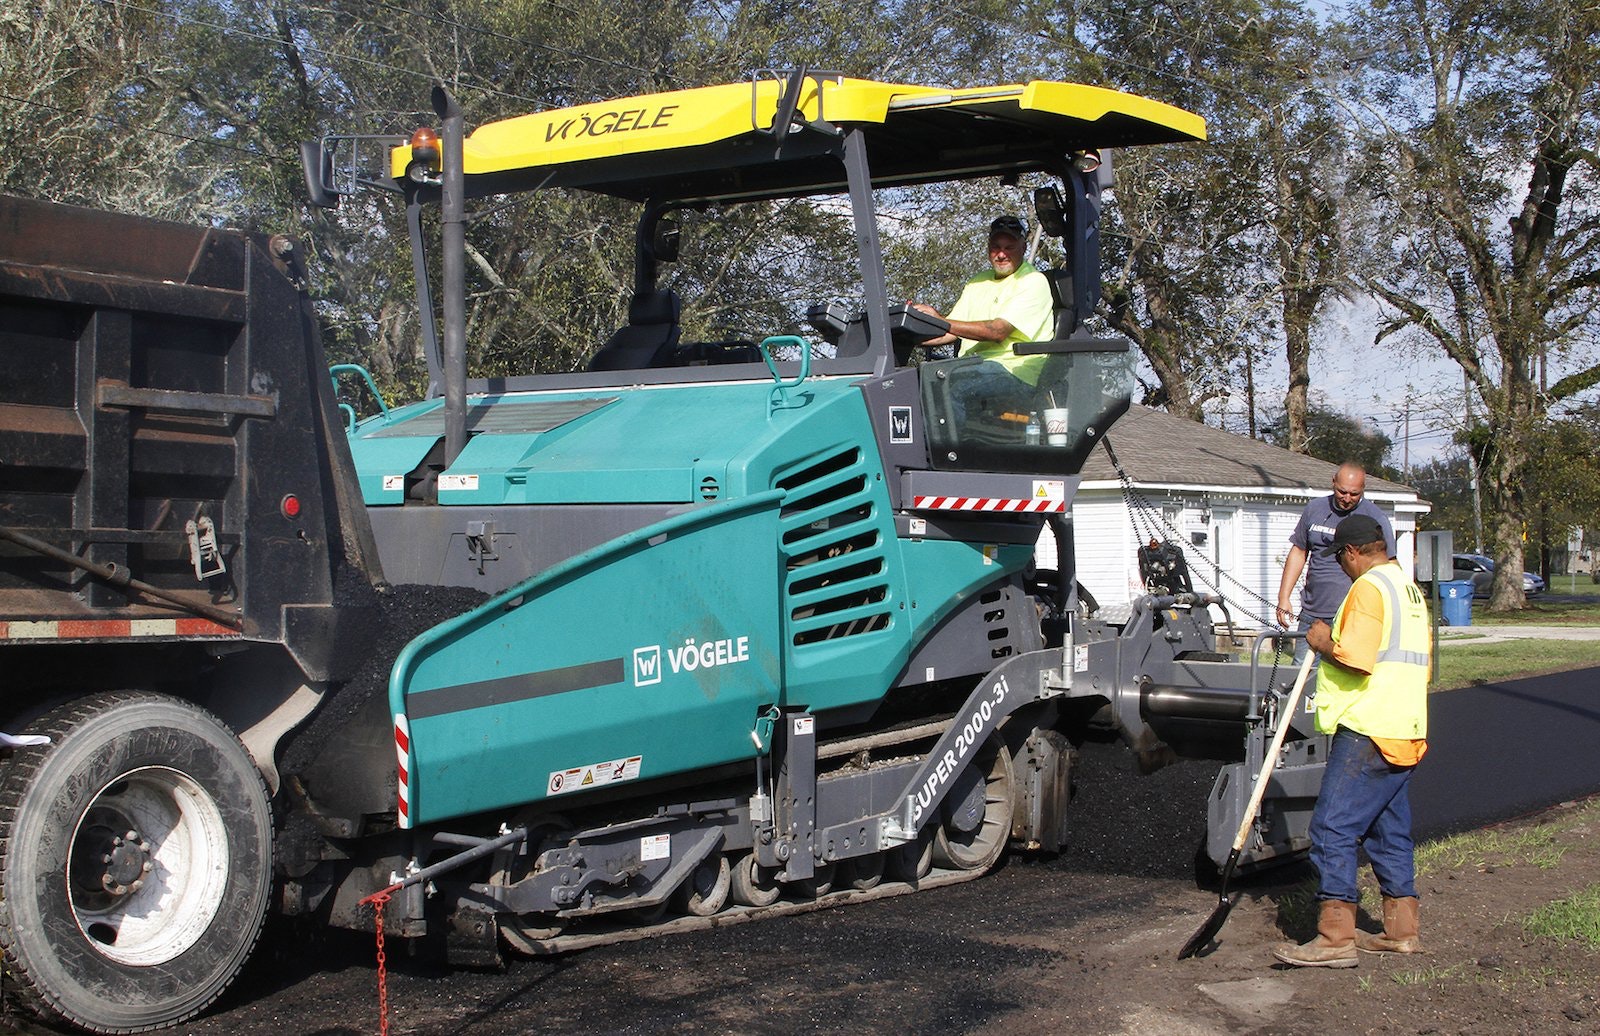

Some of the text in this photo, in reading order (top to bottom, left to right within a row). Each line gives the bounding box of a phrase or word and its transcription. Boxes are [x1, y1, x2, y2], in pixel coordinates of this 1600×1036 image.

[545, 105, 680, 143] VÖGELE
[667, 636, 750, 674] VÖGELE
[955, 674, 1010, 759] 2000-3i
